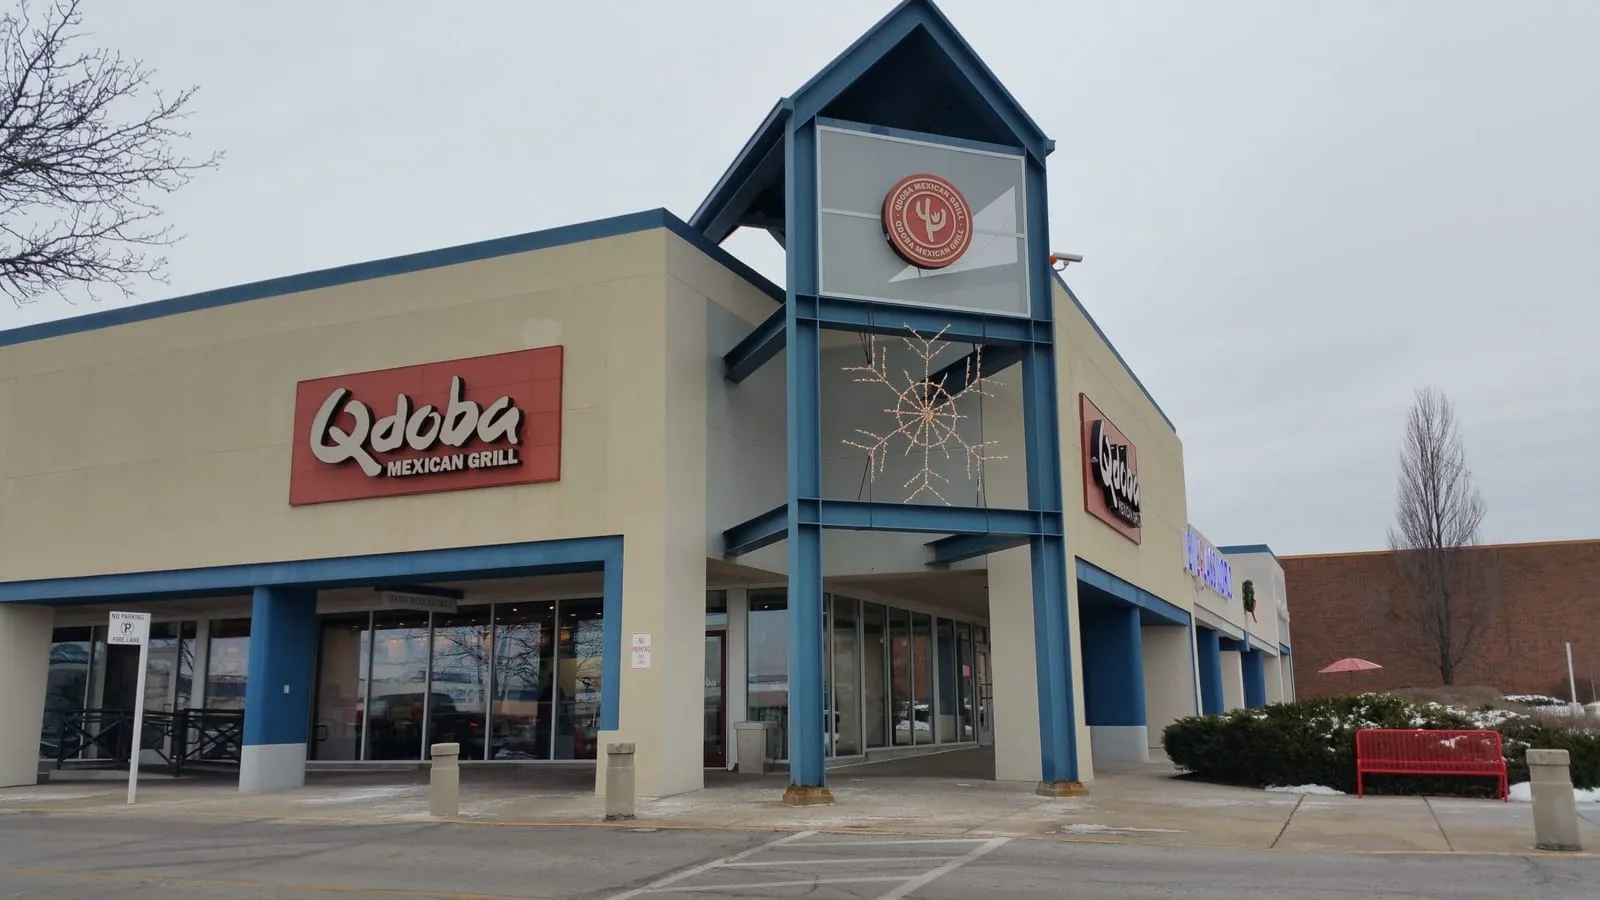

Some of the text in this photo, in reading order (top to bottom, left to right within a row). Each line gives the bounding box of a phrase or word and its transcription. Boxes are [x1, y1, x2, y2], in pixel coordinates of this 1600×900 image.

[895, 182, 965, 221] QDOBA MEXICAN GRILL
[895, 220, 964, 257] QDOBA MEXICAN GRILL
[310, 376, 521, 477] Qdoba
[387, 448, 519, 477] MEXICAN GRILL
[1096, 419, 1141, 508] Qdoba
[120, 613, 145, 621] PARKING
